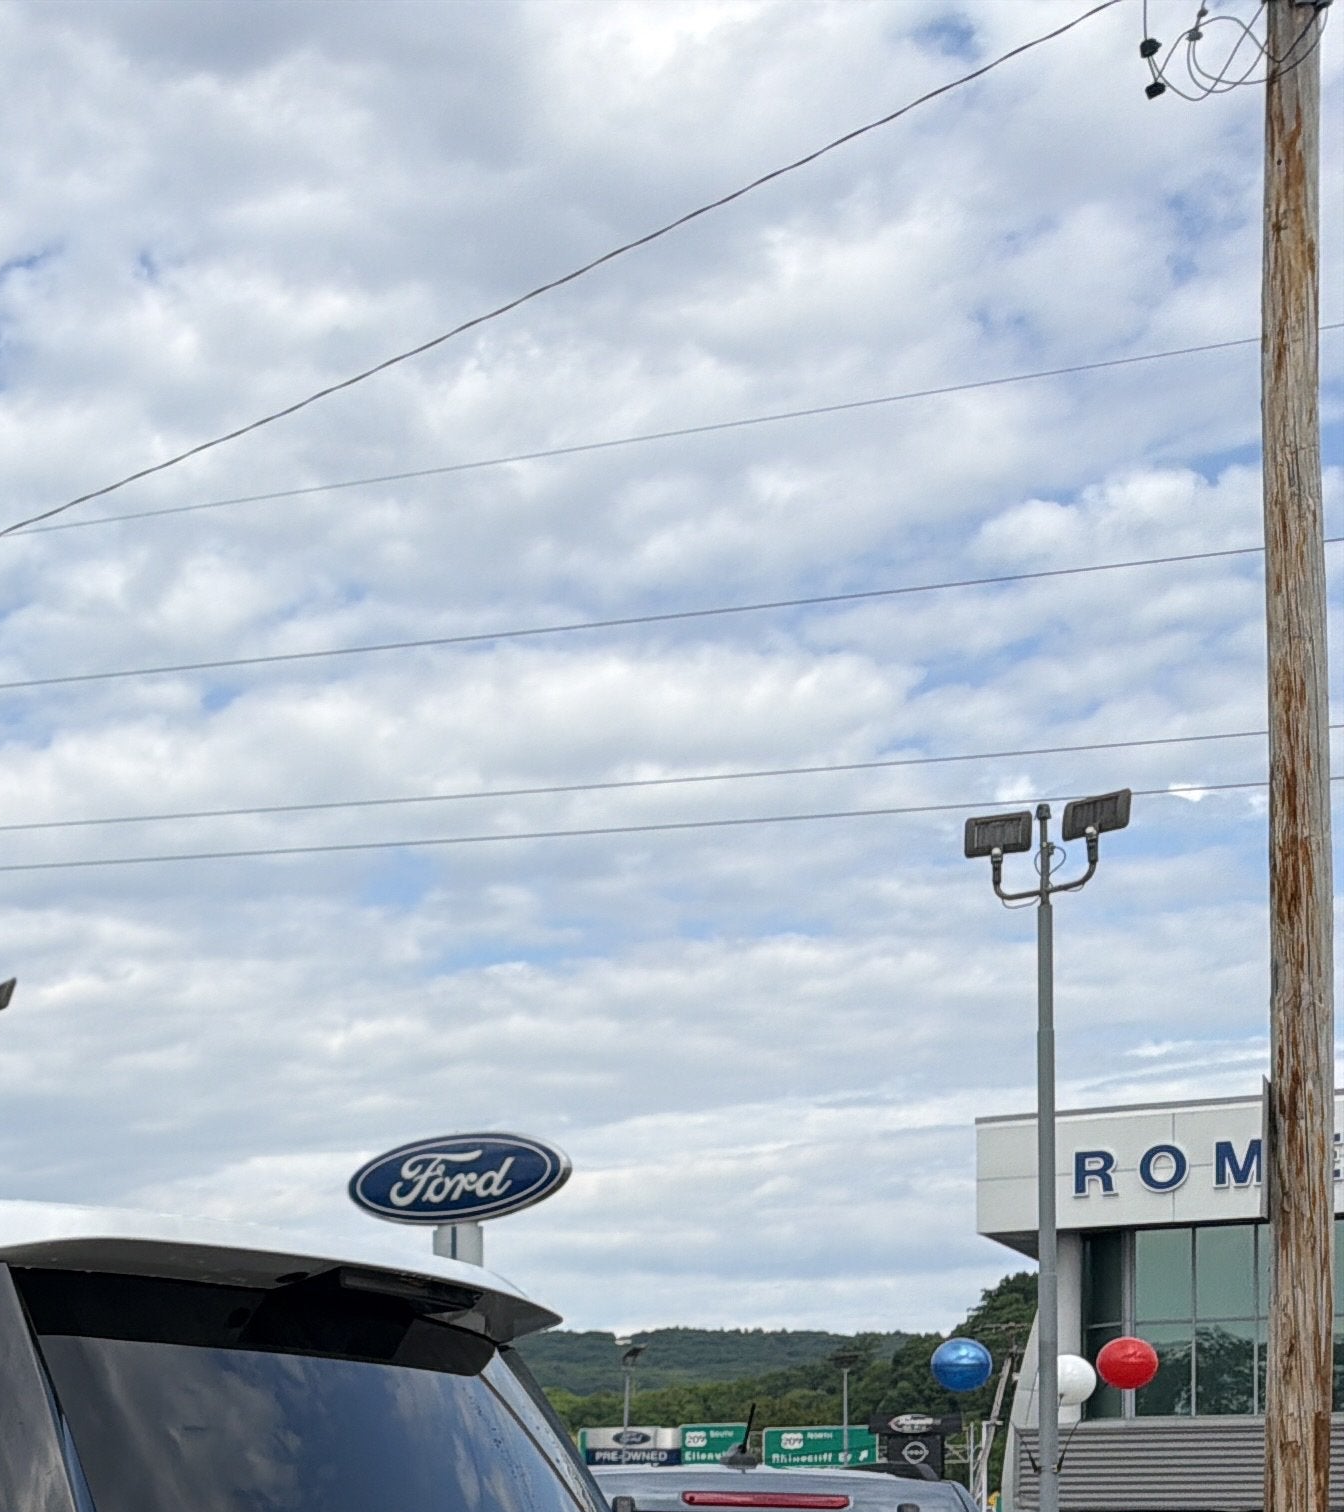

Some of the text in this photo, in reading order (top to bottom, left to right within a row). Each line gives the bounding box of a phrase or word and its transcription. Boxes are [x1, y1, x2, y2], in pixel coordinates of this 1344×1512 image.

[389, 1149, 516, 1208] Ford
[1073, 1131, 1344, 1197] ROM
[595, 1450, 668, 1462] PRE-OWNED
[685, 1433, 706, 1445] 209
